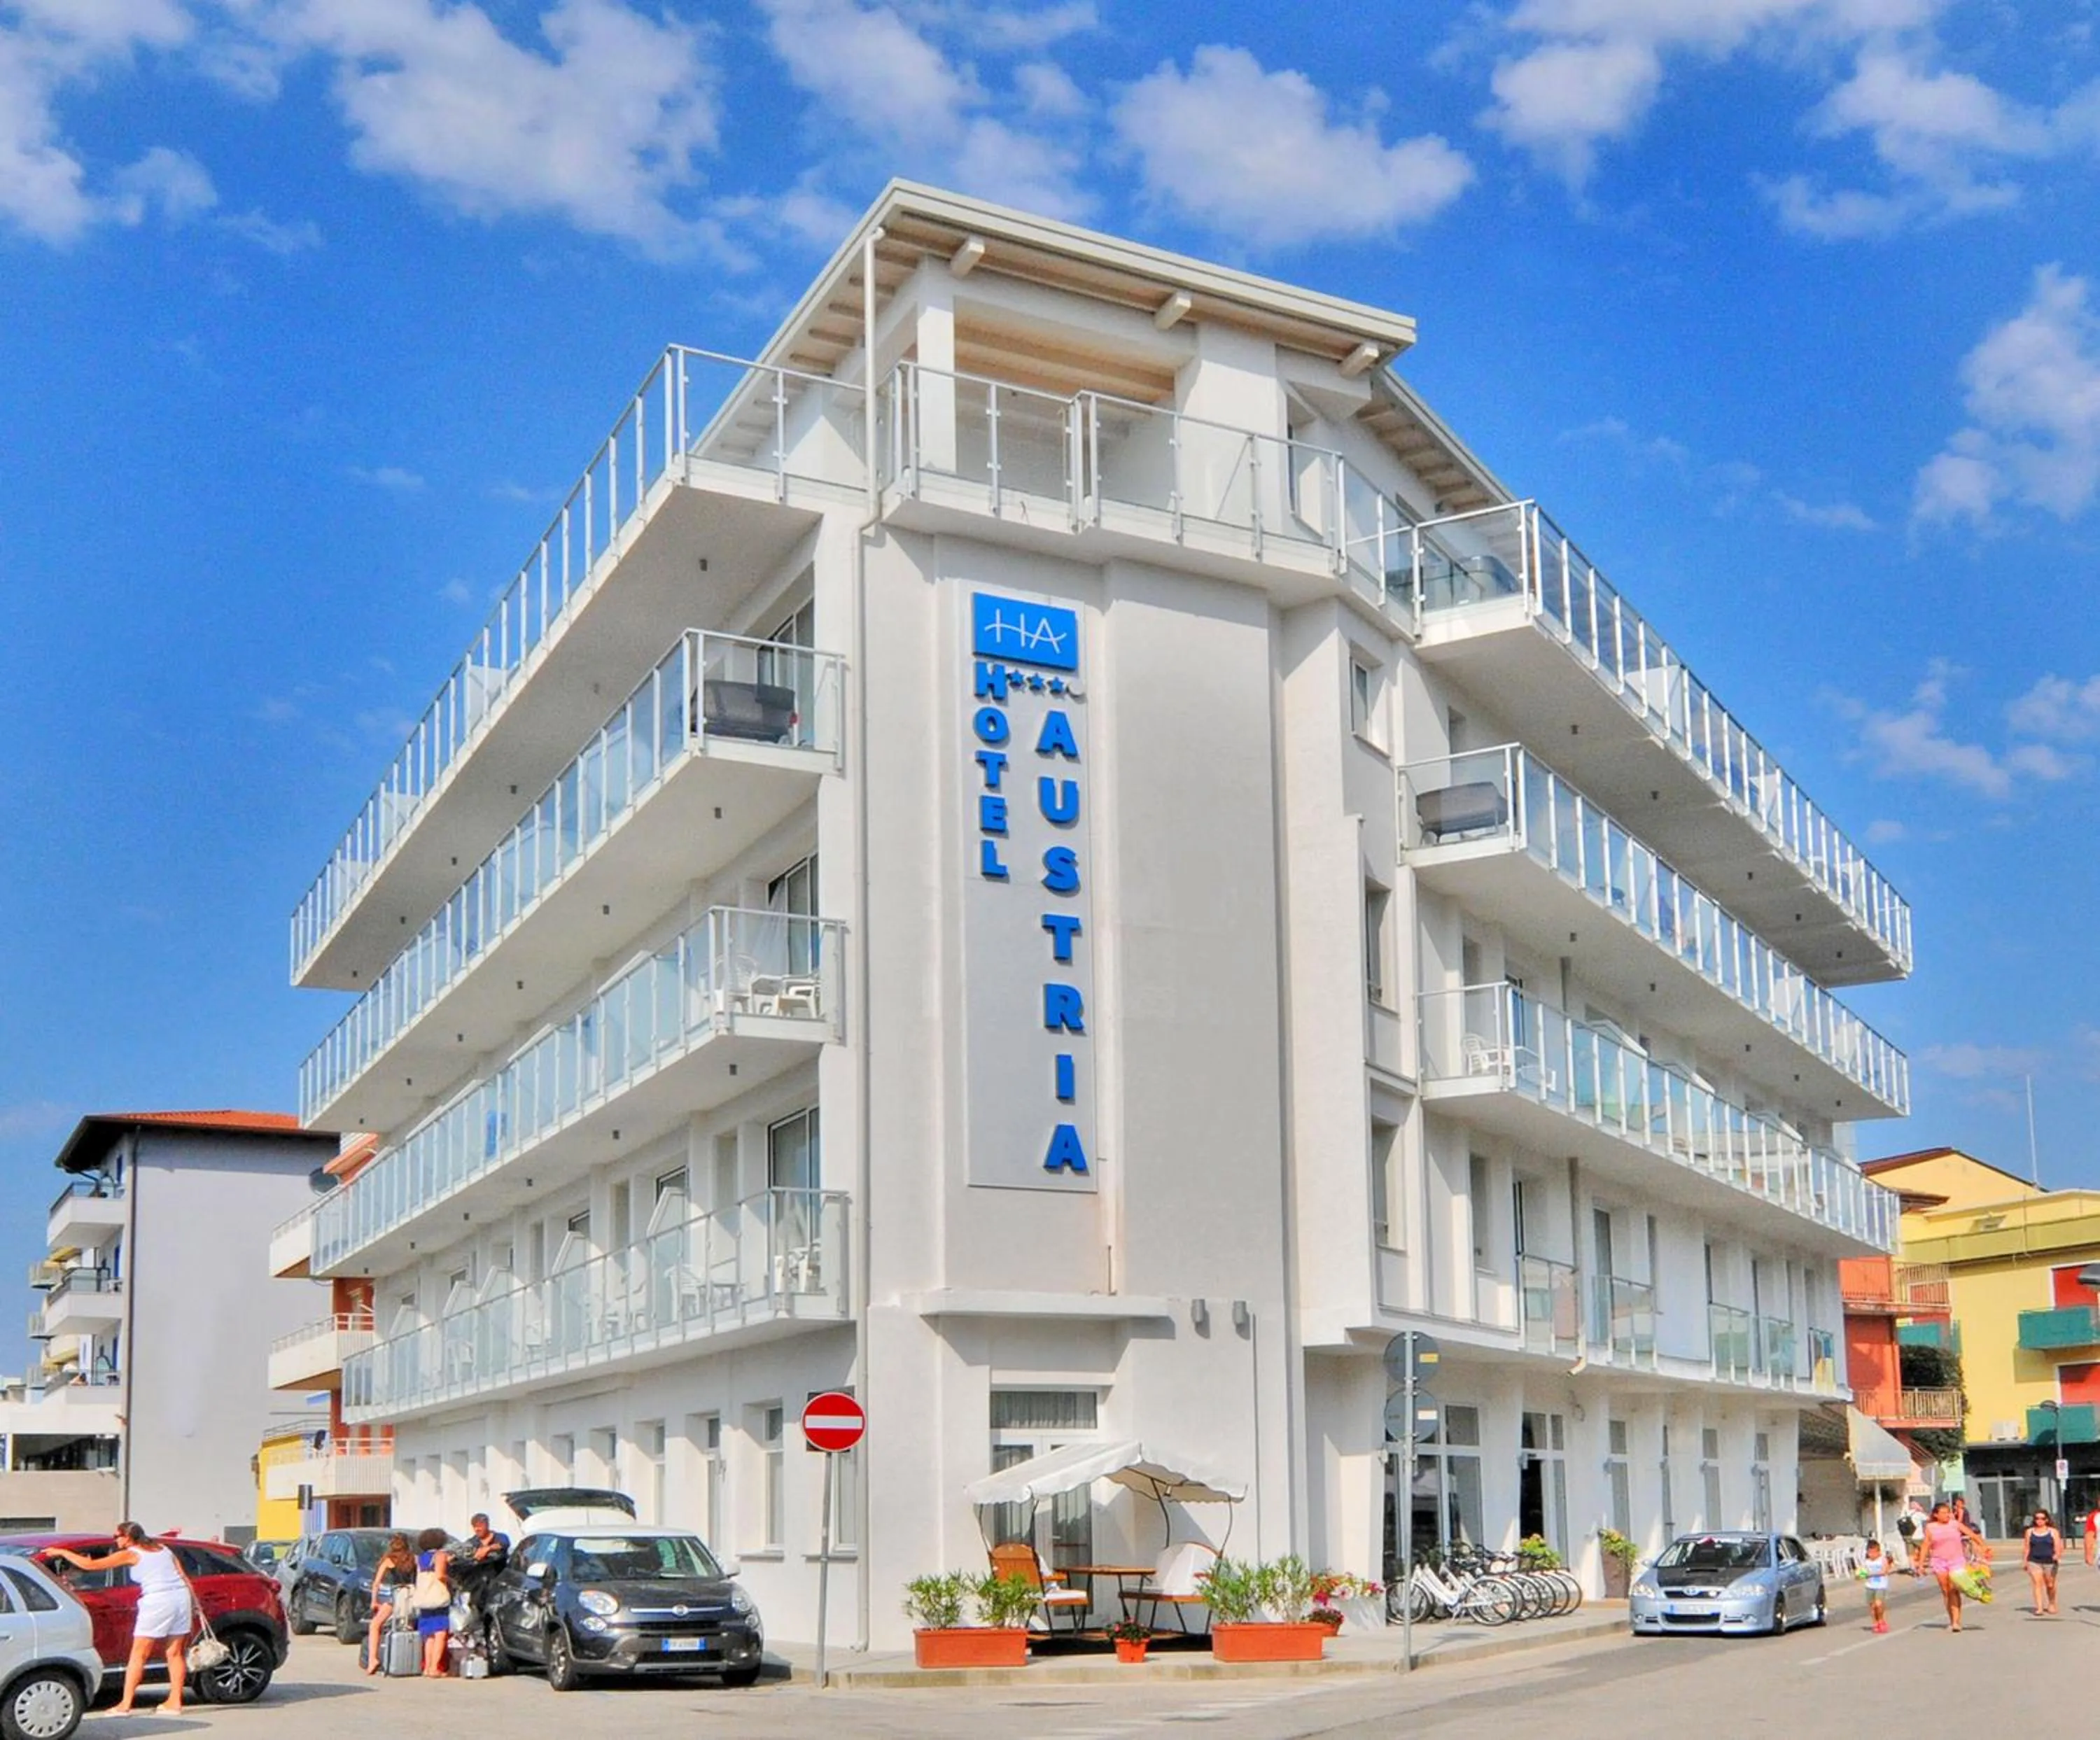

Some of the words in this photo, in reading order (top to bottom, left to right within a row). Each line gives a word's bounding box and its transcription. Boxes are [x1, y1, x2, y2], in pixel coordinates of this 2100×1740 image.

[984, 608, 1068, 654] HA
[974, 661, 1009, 876] HOTEL
[1036, 710, 1088, 1174] AUSTRIA
